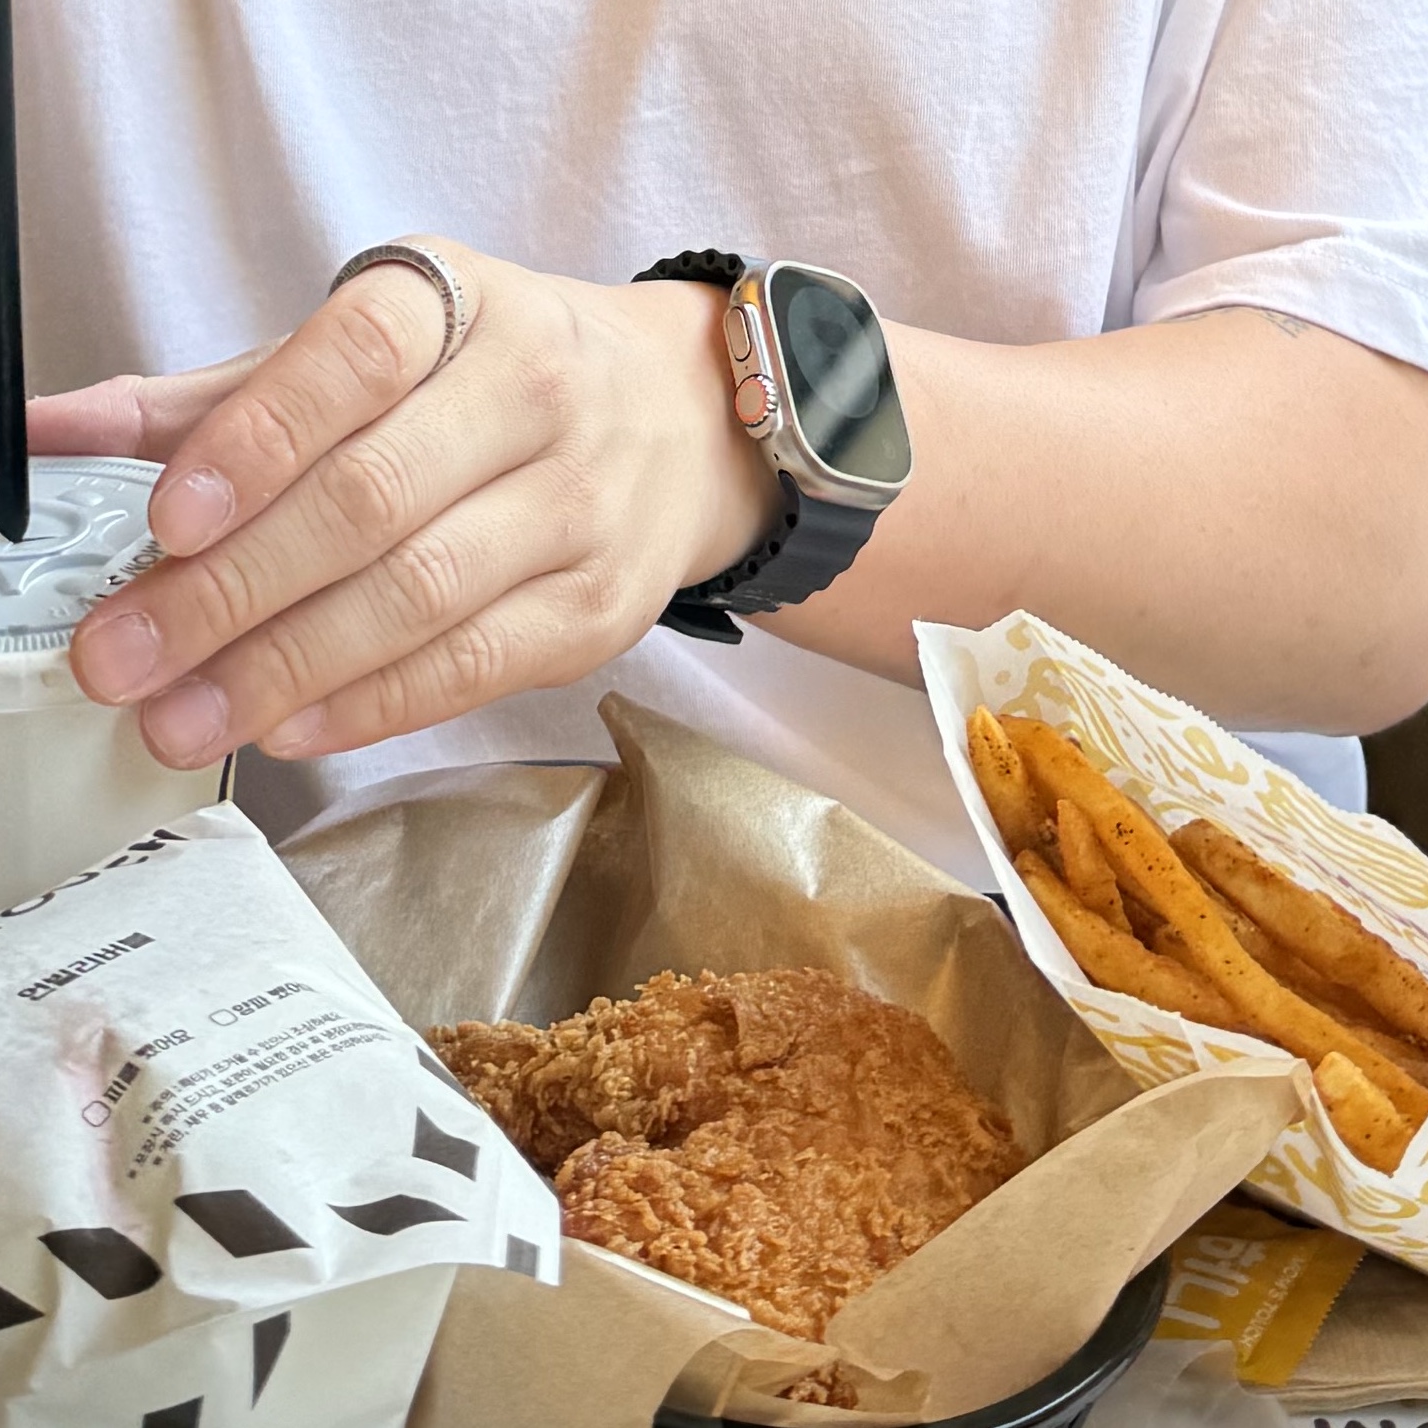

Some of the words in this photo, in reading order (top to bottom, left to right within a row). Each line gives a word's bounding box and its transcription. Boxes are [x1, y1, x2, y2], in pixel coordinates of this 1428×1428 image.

[17, 932, 156, 1001] 언빌리버블
[103, 1061, 140, 1104] 피클
[232, 994, 272, 1016] 양파
[220, 1067, 256, 1087] 보관이
[253, 1051, 289, 1071] 필요한
[286, 1041, 309, 1055] 경우
[258, 1031, 294, 1050] 있으니
[184, 1108, 209, 1127] 새우
[207, 1101, 225, 1114] 등
[1238, 1298, 1279, 1347] TOUCH
